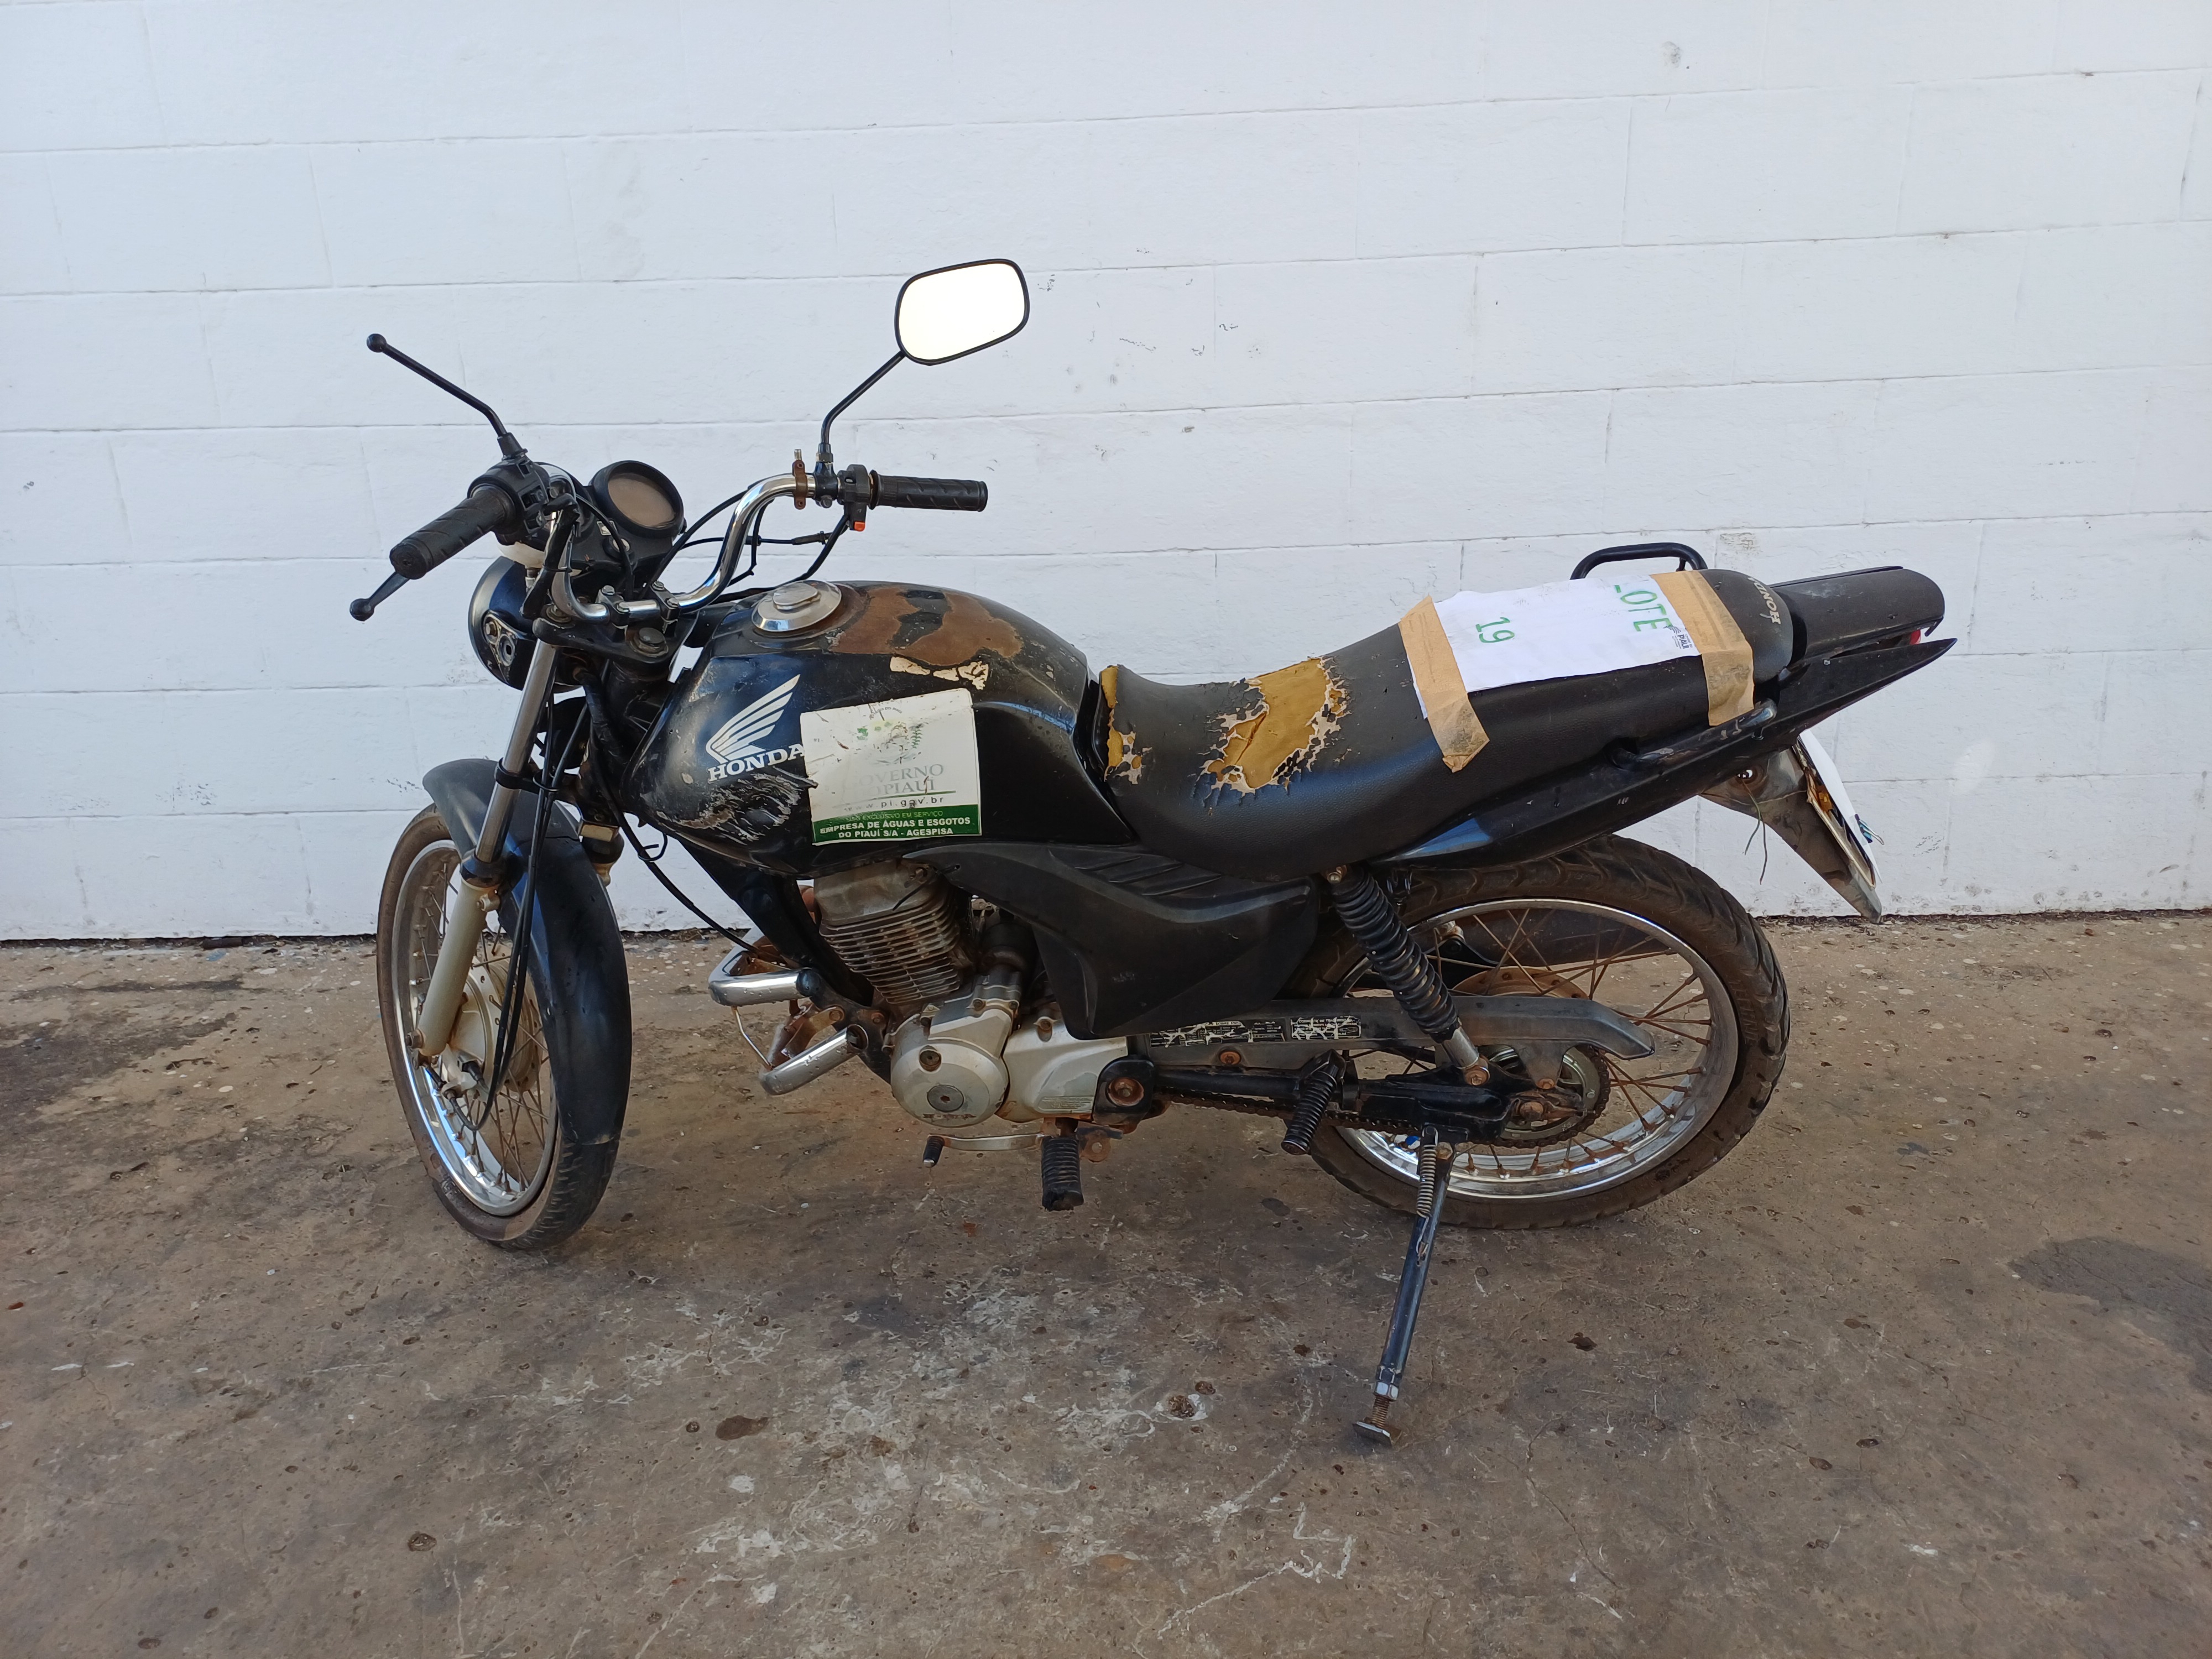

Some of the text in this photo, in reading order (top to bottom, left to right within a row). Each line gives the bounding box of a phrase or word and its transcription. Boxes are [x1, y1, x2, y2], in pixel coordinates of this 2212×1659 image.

[1475, 617, 1515, 643] 19
[707, 743, 805, 782] HONDA
[854, 763, 945, 787] OVERNO
[820, 822, 864, 834] EMPRESA
[867, 821, 880, 830] DE
[882, 818, 915, 828] ÁGUAS
[926, 817, 971, 826] ESGOTOS
[854, 828, 880, 838] PIAUÍ
[906, 827, 953, 837] AGESPISA
